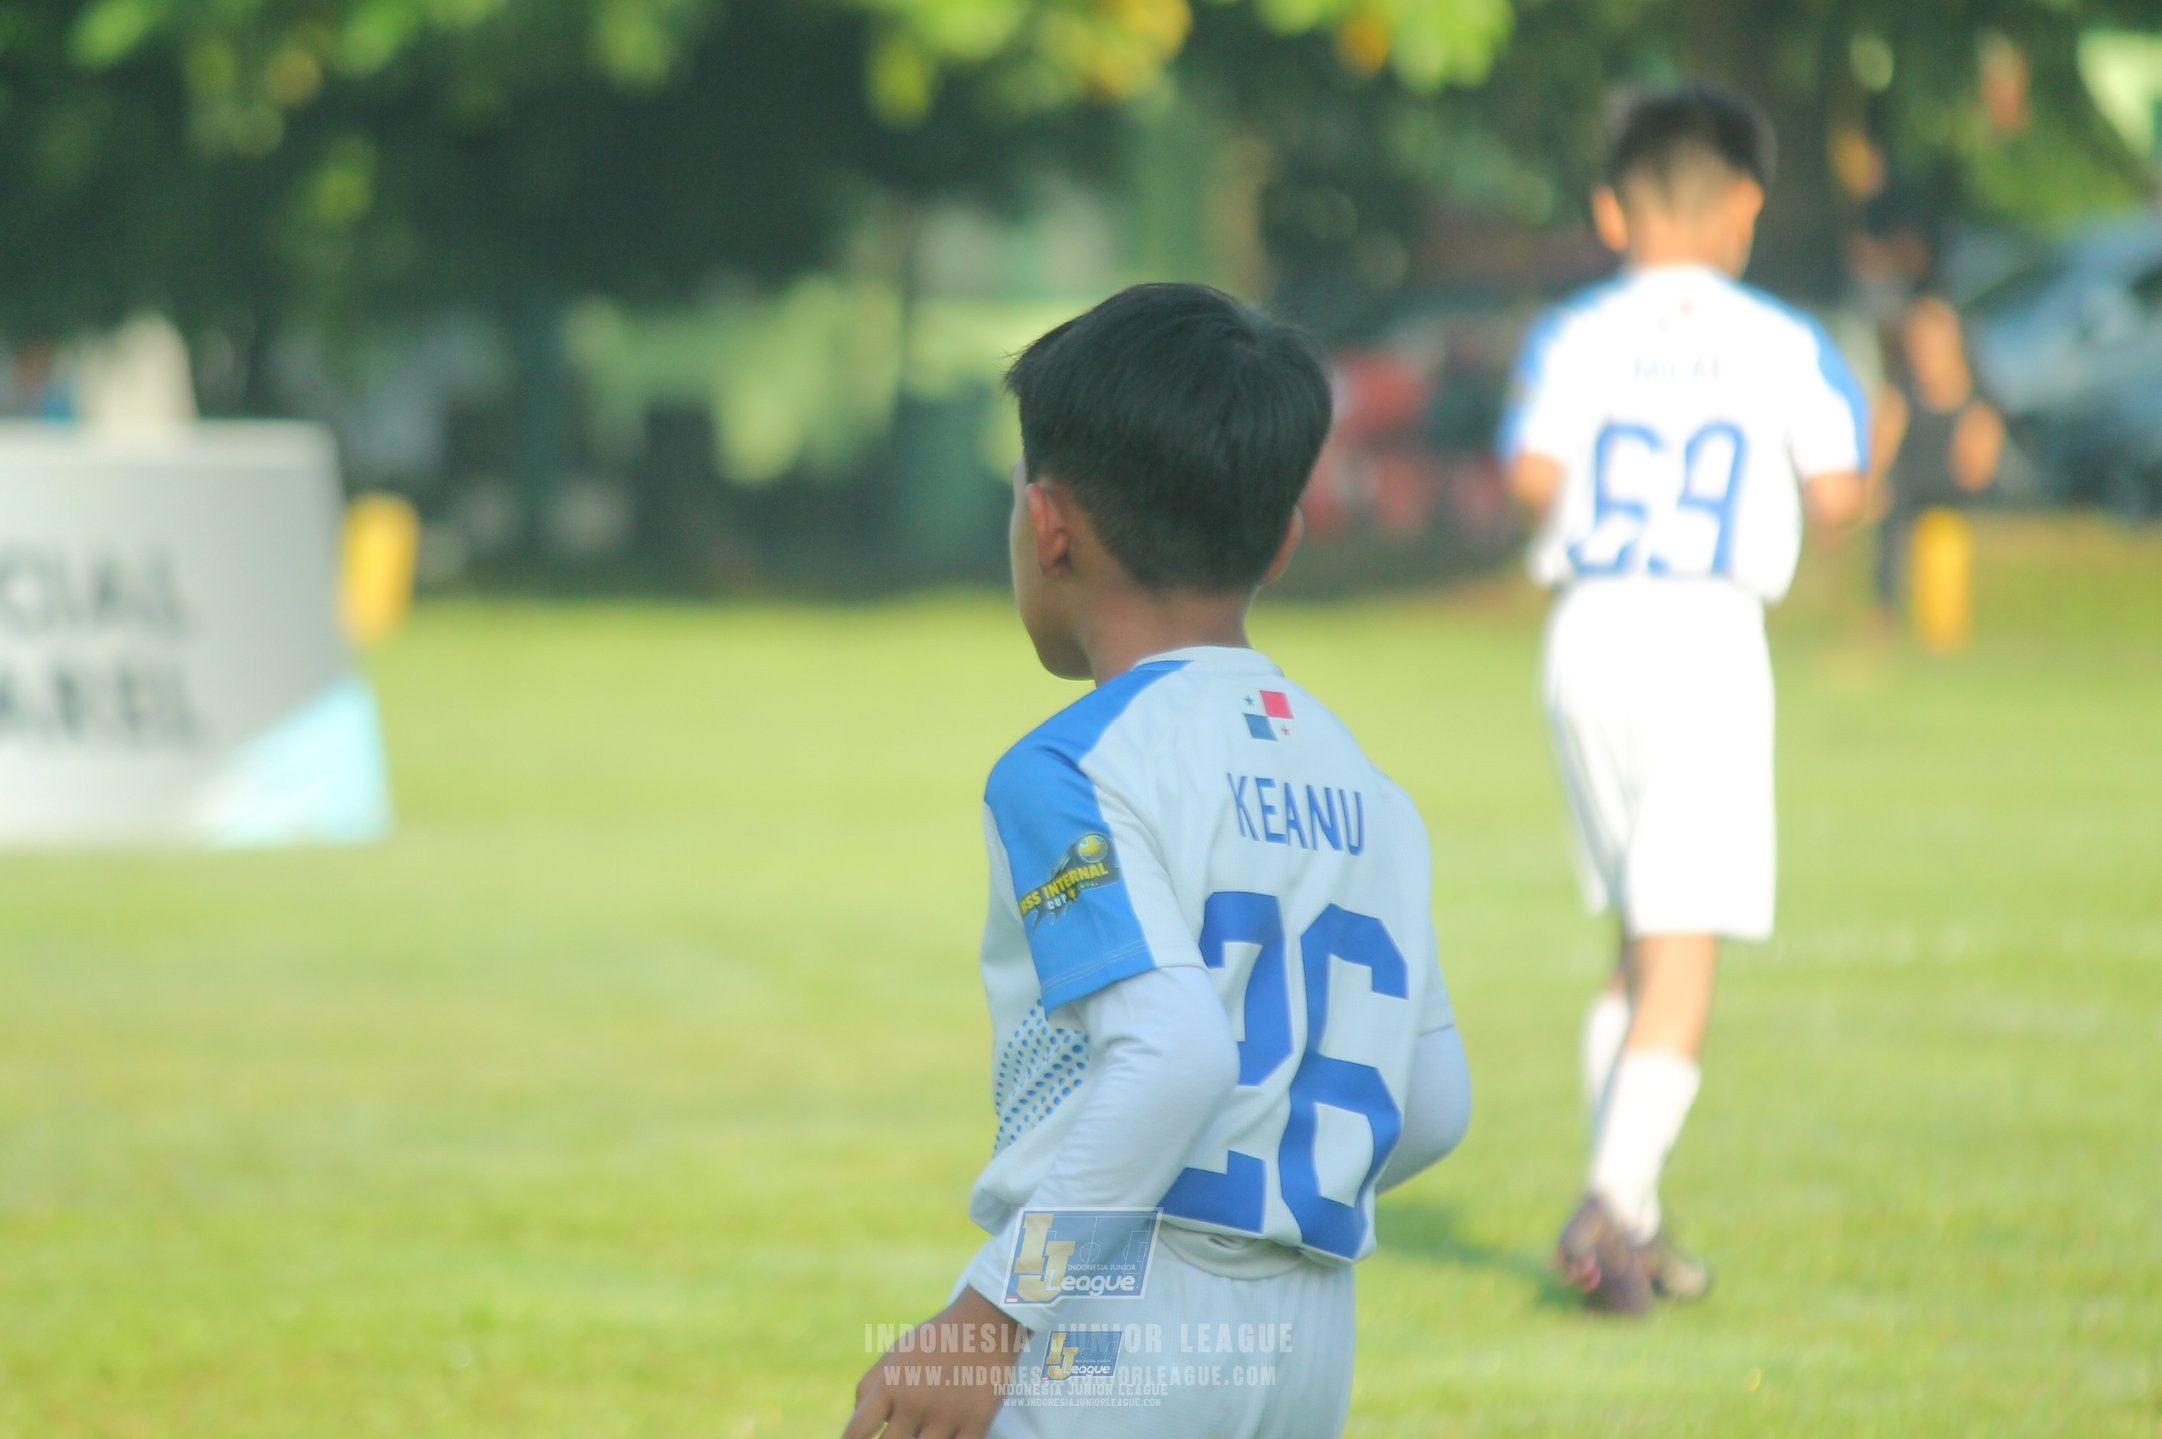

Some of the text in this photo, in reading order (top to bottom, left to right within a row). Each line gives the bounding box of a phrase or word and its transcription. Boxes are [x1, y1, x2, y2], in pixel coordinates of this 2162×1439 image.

[1225, 772, 1365, 857] KEANU
[1042, 862, 1109, 900] INTERNAL
[1047, 893, 1068, 910] CUP
[1157, 891, 1409, 1260] 26
